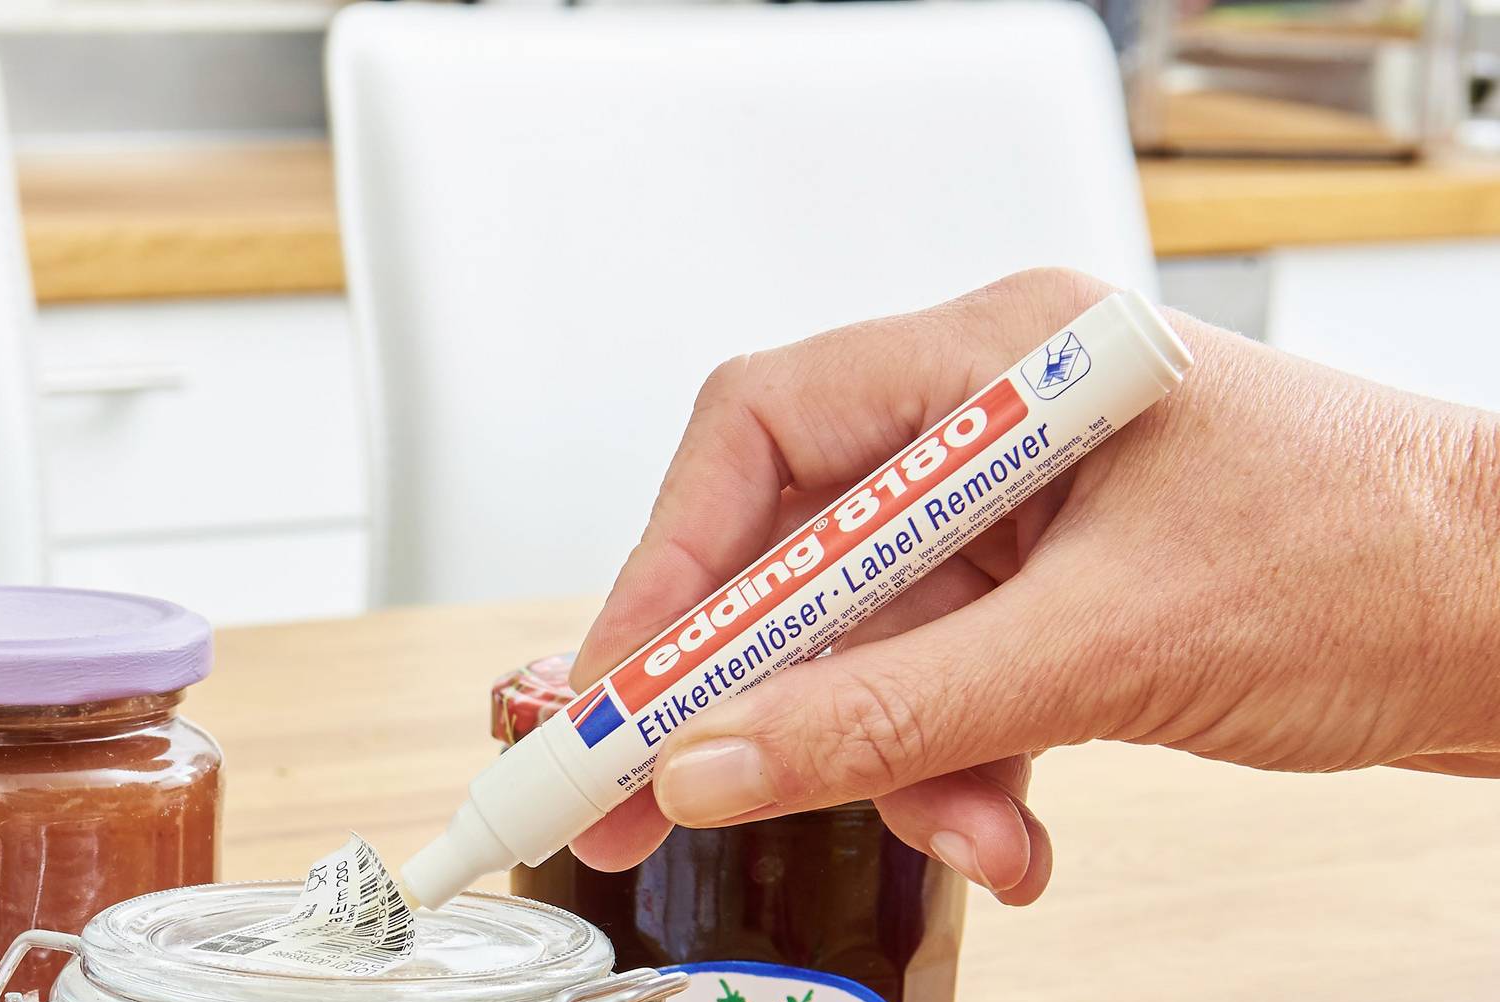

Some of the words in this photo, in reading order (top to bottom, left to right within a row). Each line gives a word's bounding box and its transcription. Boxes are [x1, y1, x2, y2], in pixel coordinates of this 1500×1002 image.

[834, 405, 988, 533] 8180
[616, 774, 632, 787] EN
[772, 646, 803, 671] residue
[809, 618, 840, 644] precise
[840, 604, 857, 620] and
[857, 589, 878, 606] easy
[877, 581, 889, 590] to
[889, 563, 913, 583] apply
[968, 494, 1005, 523] contains
[1004, 470, 1035, 495] natural
[1035, 435, 1083, 473] ingredients
[1088, 416, 1108, 432] test
[636, 591, 828, 748] Etikettenlöser
[841, 516, 924, 594] Label
[924, 423, 1050, 531] Remover
[893, 577, 908, 589] DE
